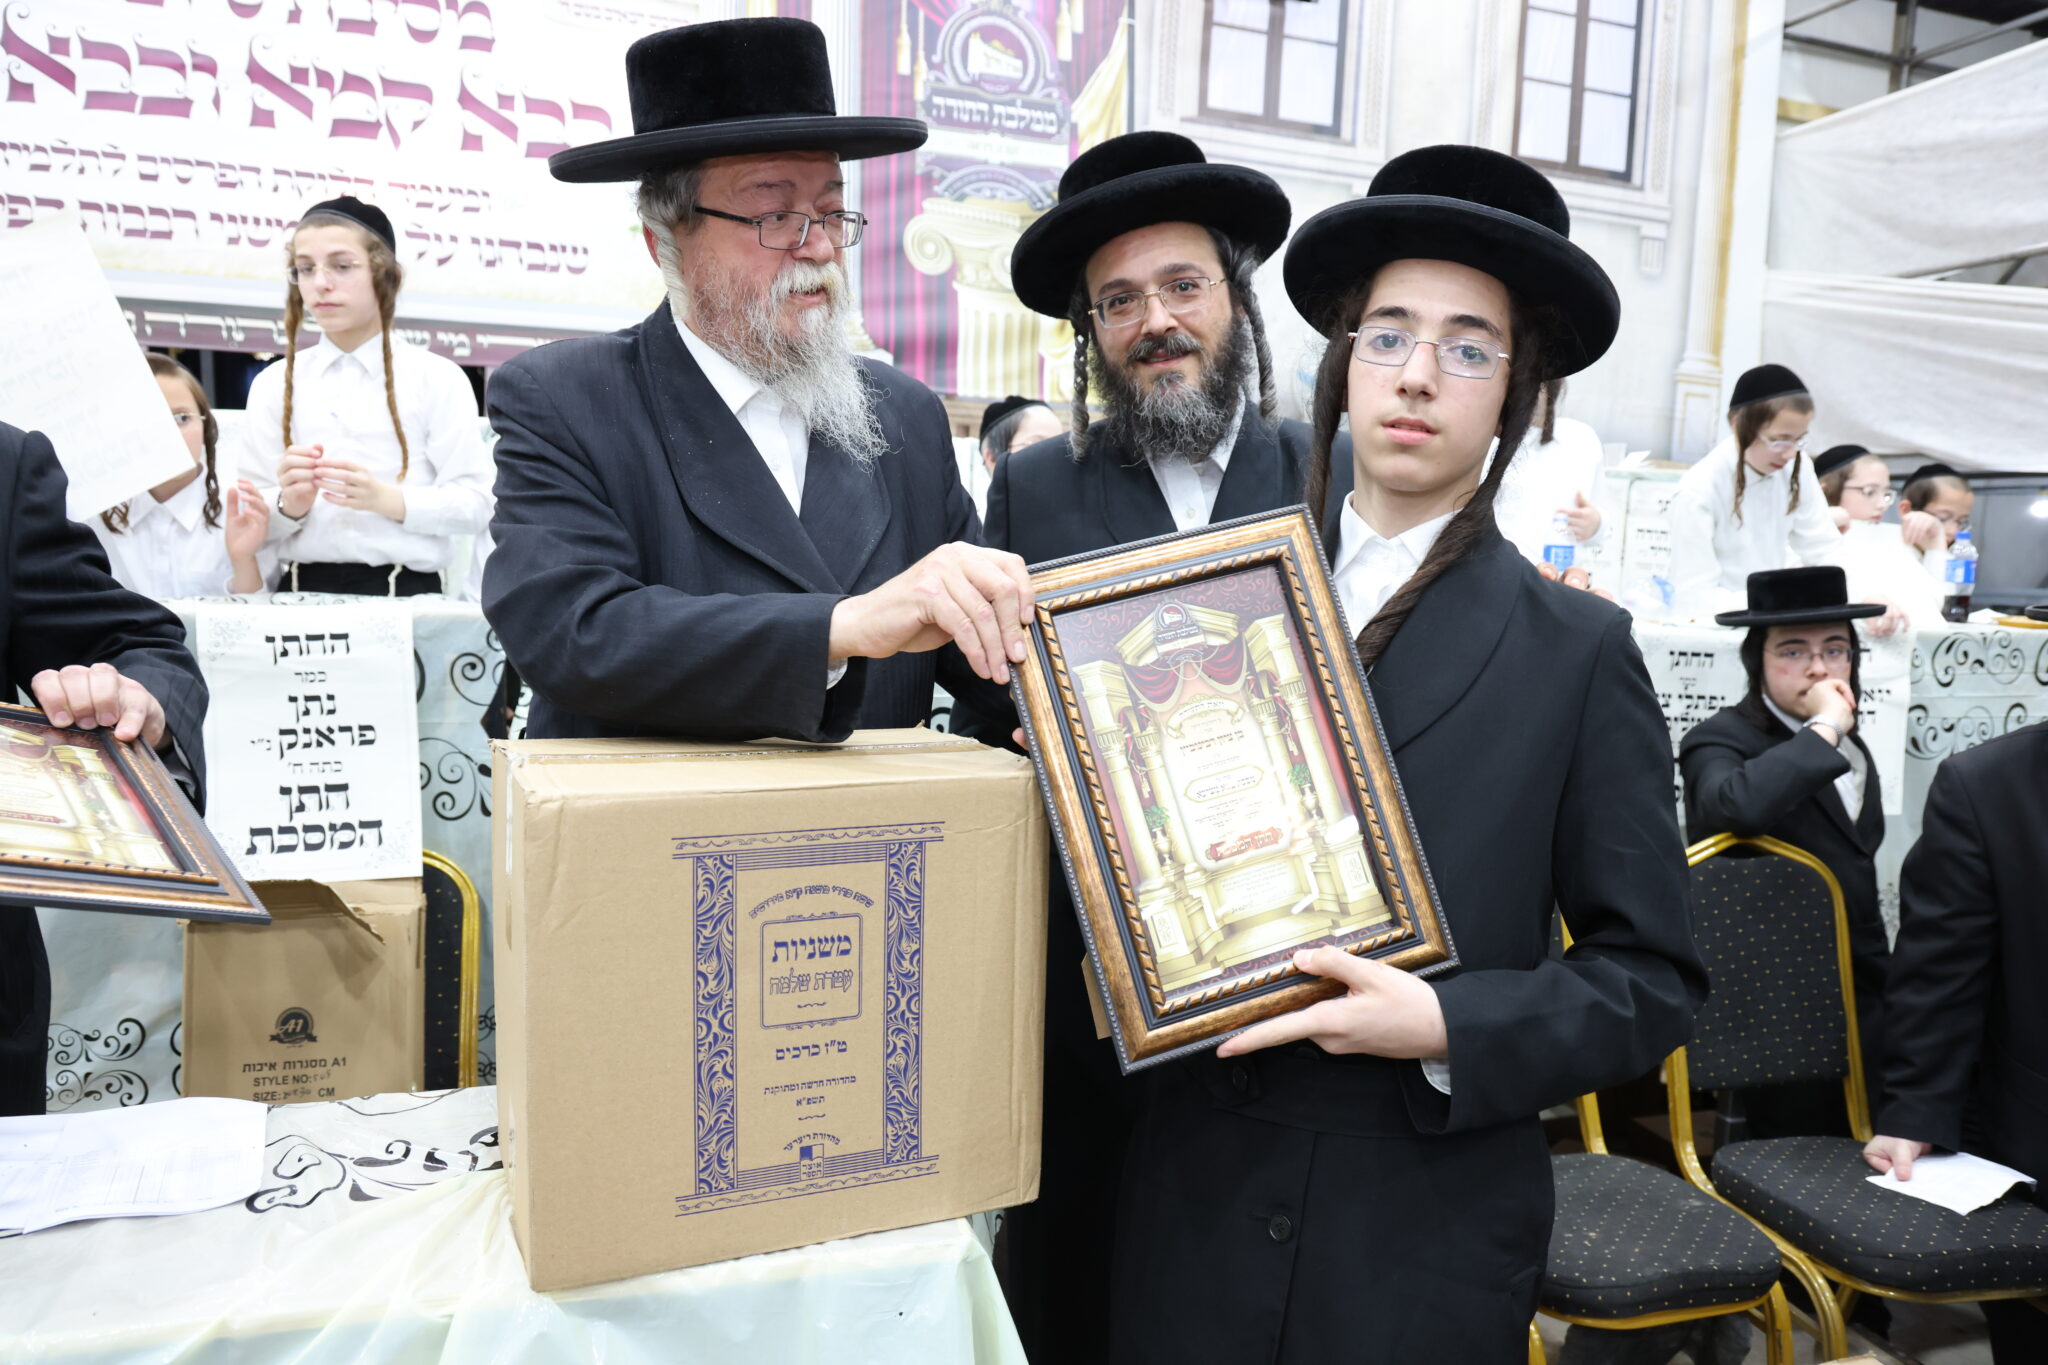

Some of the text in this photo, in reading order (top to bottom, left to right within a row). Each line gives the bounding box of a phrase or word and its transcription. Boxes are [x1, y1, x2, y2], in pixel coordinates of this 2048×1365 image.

[245, 35, 434, 151] קמא
[932, 95, 1059, 134] ממלכת התורה
[136, 154, 262, 188] הפרסים
[79, 199, 199, 240] רבבות
[404, 222, 458, 267] על
[471, 236, 589, 275] שנבחנו
[265, 632, 350, 666] החתן
[1669, 650, 1715, 672] החתן
[293, 671, 328, 683] כמר
[287, 693, 337, 723] נתן
[278, 724, 377, 760] פראנק
[279, 782, 350, 823] חתן
[245, 819, 383, 856] המסכת
[771, 934, 853, 963] משניות
[769, 967, 854, 995] עטרת שלמה
[331, 1057, 347, 1067] A1
[775, 1039, 848, 1061] ט"ז כרכים
[242, 1062, 277, 1073] איכות
[253, 1075, 289, 1087] STYLE
[292, 1074, 312, 1085] NO:
[825, 1075, 857, 1087] מהדורה
[253, 1090, 282, 1102] SIZE:
[318, 1087, 335, 1098] CM
[800, 1079, 825, 1091] חדשה
